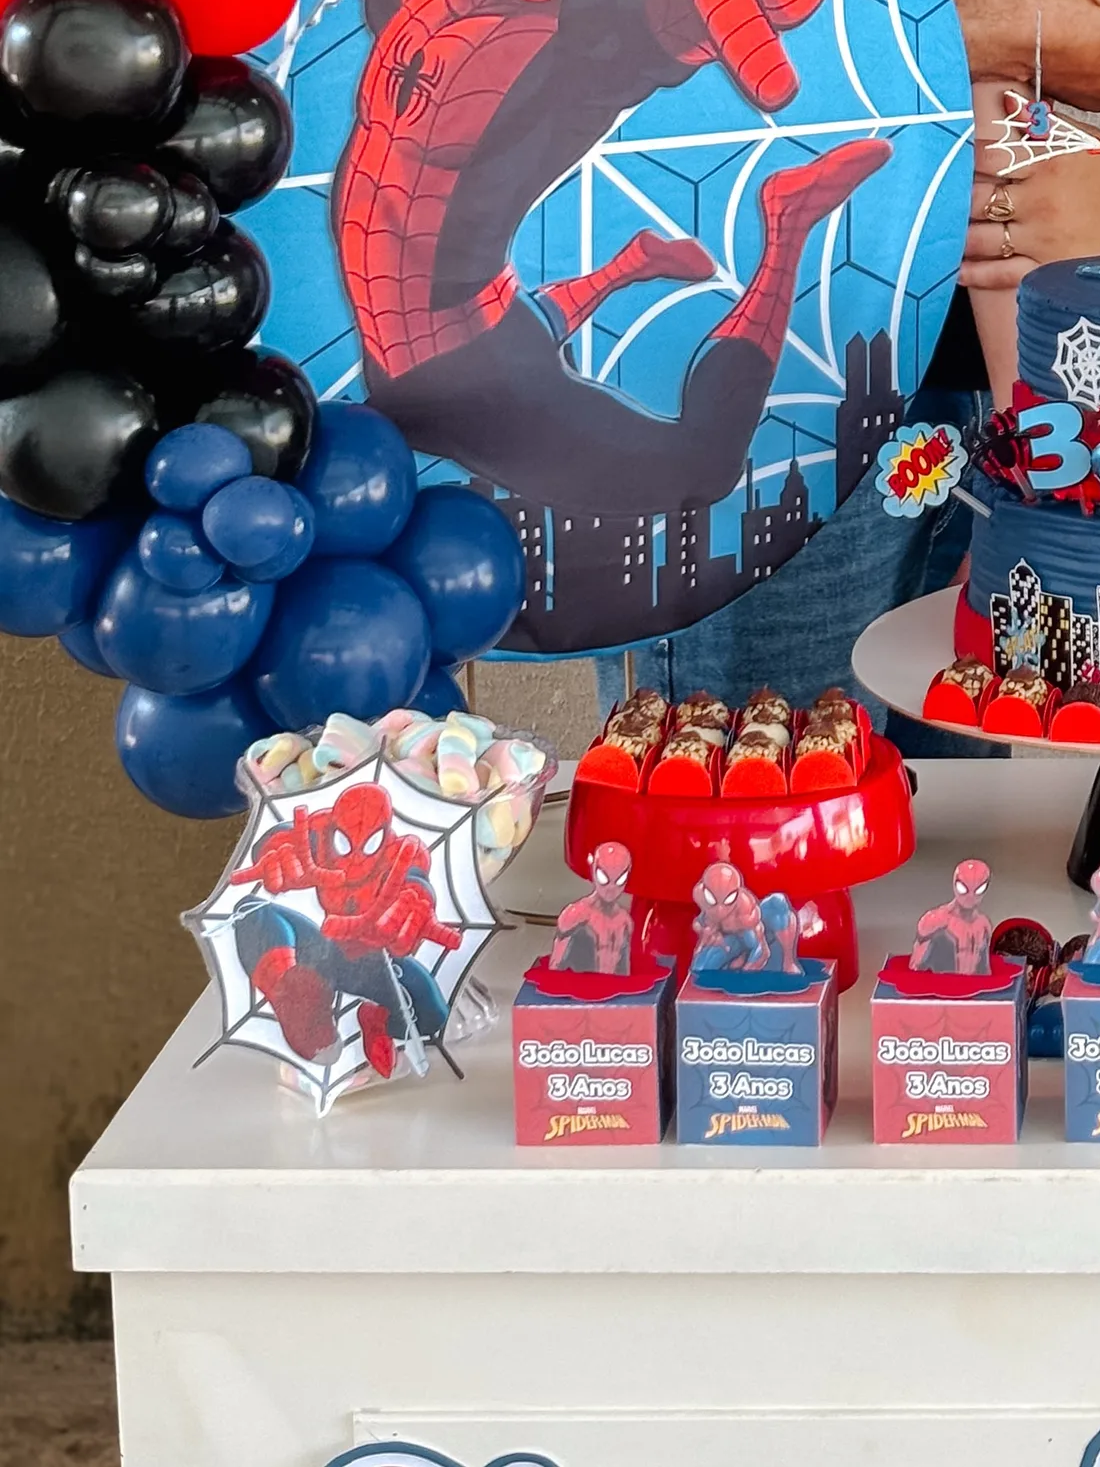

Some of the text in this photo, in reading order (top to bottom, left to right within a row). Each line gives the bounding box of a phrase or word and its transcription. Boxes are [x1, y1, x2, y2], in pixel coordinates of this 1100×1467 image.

[1028, 101, 1050, 136] 3
[1018, 401, 1091, 490] 3
[886, 427, 954, 501] BOOM!
[520, 1039, 652, 1066] João Lucas
[682, 1037, 814, 1065] João Lucas
[878, 1036, 1011, 1064] João Lucas
[548, 1074, 631, 1101] 3 Anos
[710, 1072, 792, 1099] 3 Anos
[906, 1071, 989, 1098] 3 Anos
